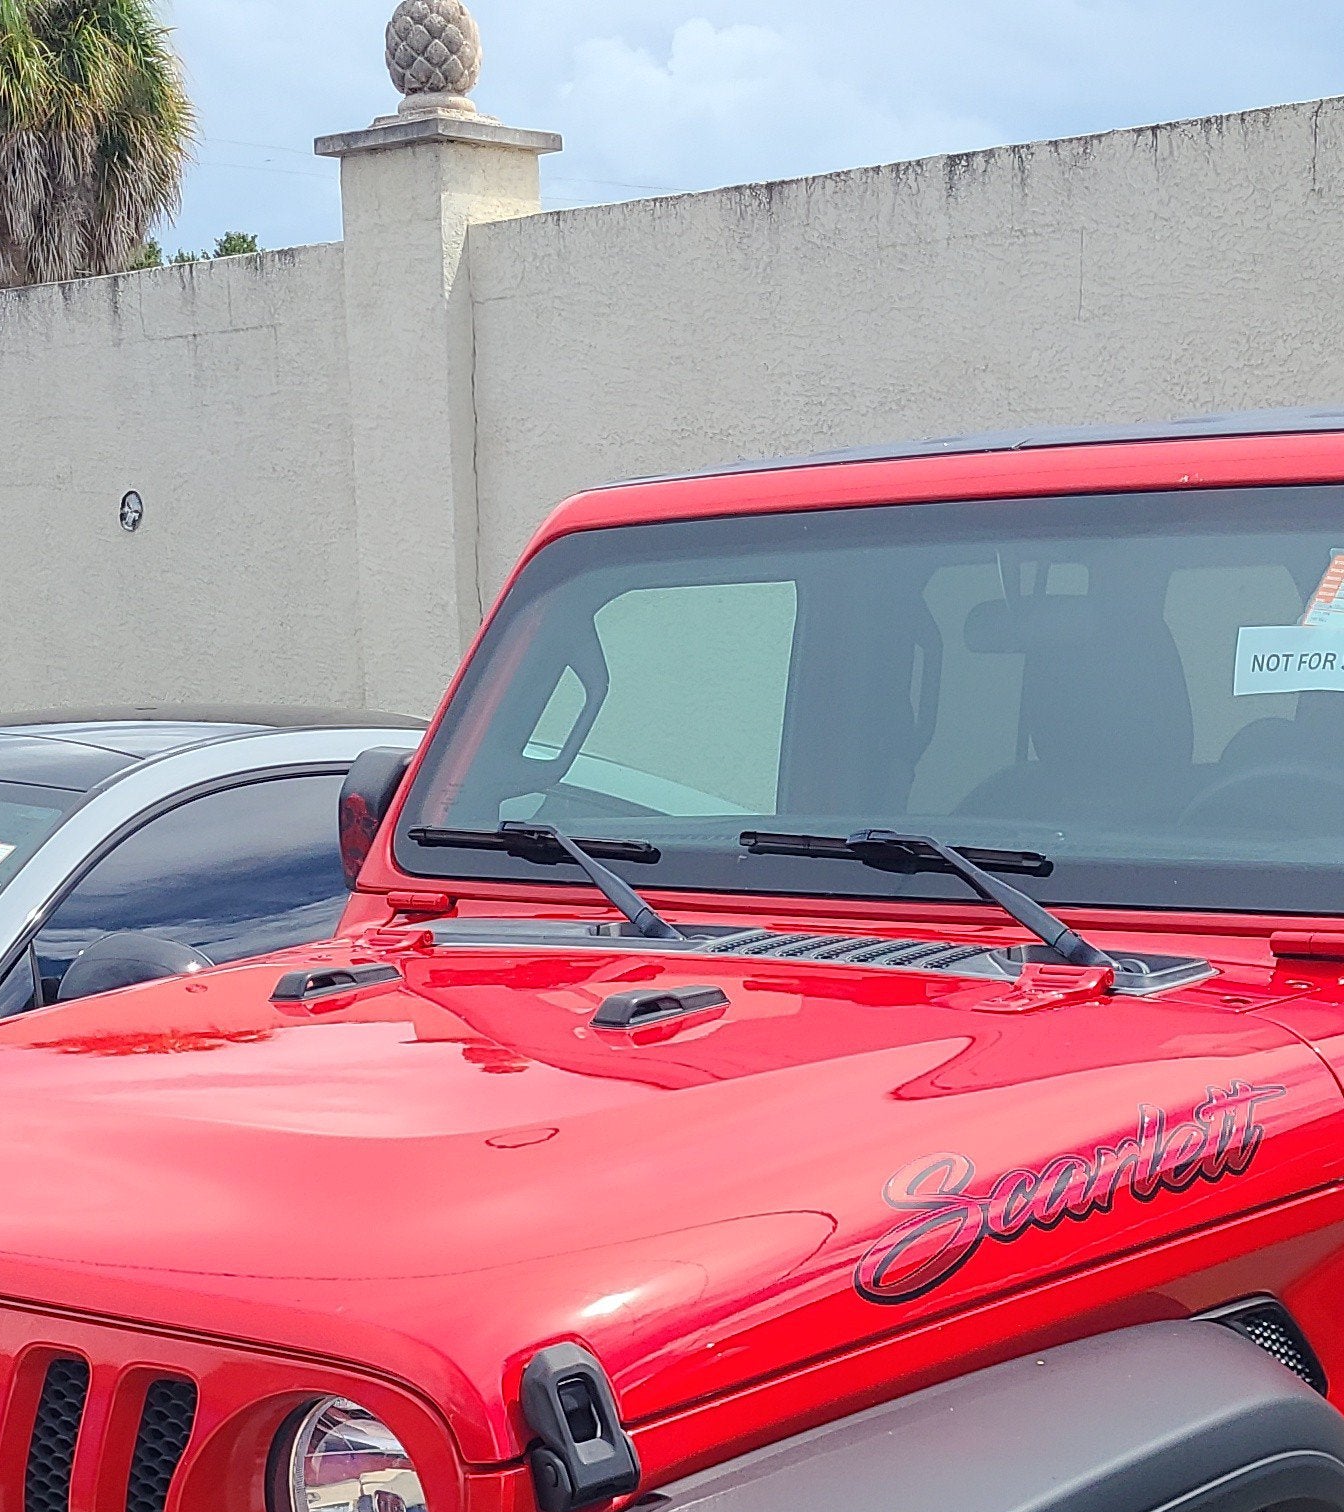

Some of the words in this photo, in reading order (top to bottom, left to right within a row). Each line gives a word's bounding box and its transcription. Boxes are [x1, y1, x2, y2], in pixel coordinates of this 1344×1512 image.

[1251, 653, 1293, 672] NOT
[1297, 652, 1336, 671] FOR
[852, 1079, 1288, 1304] Scarlett
